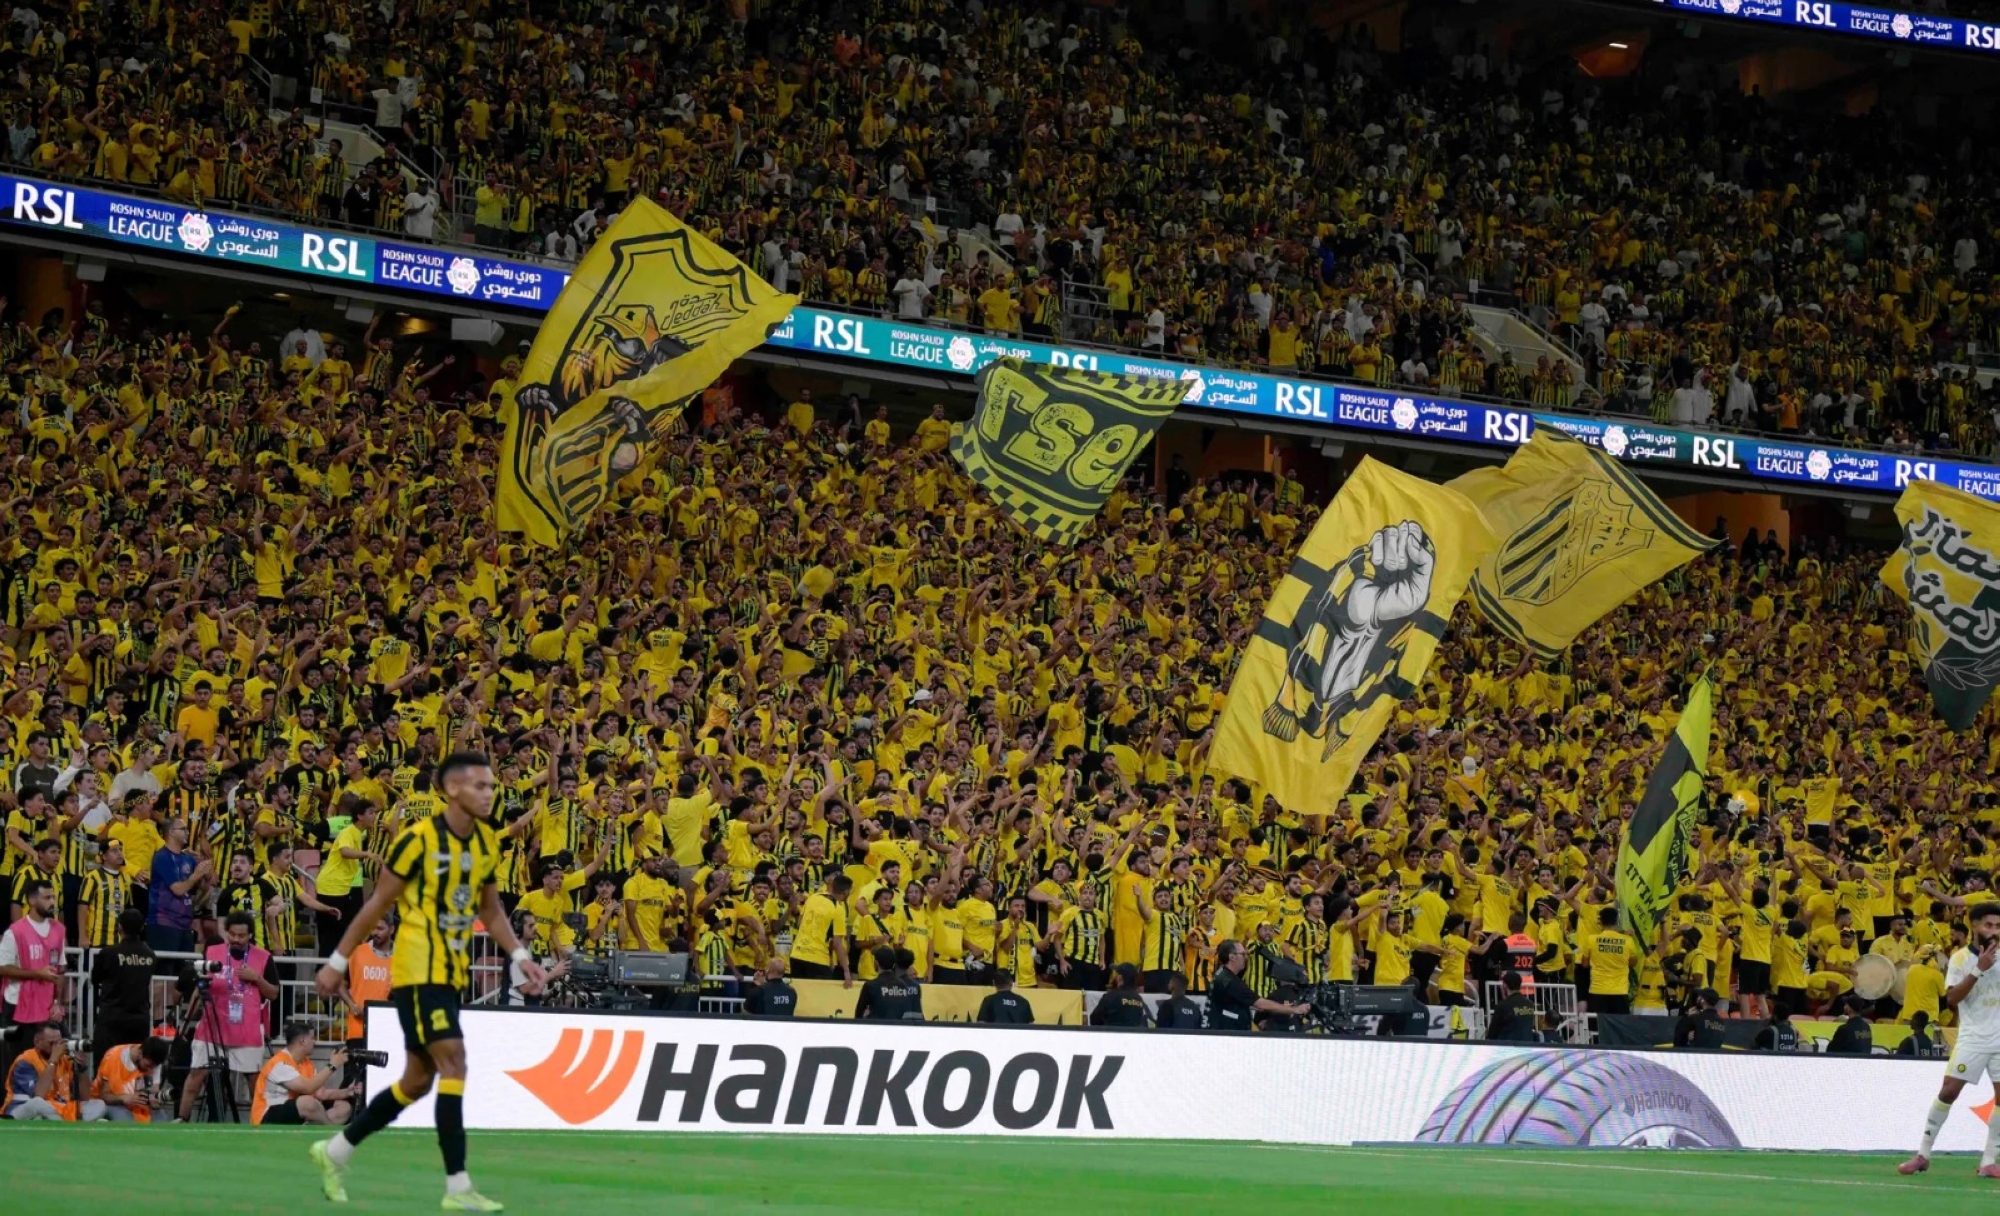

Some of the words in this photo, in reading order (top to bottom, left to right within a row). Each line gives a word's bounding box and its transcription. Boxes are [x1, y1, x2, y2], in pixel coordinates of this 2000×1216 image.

[1795, 1, 1837, 27] RSL
[1850, 18, 1890, 34] LEAGUE
[13, 183, 84, 229] RSL
[110, 203, 144, 218] ROSHN
[145, 208, 175, 223] SAUDI
[108, 216, 174, 242] LEAGUE
[217, 219, 249, 236] روشن
[251, 227, 279, 241] دوري
[216, 240, 279, 259] السعودي
[301, 233, 366, 277] RSL
[383, 249, 416, 264] ROSHN
[416, 253, 444, 268] SAUDI
[382, 262, 443, 287] LEAGUE
[483, 263, 514, 281] روشن
[515, 271, 542, 283] دوري
[483, 283, 541, 300] السعودي
[813, 314, 870, 354] RSL
[891, 330, 919, 342] ROSHN
[920, 333, 945, 346] SAUDI
[890, 343, 944, 364] LEAGUE
[1124, 363, 1150, 376] ROSHN
[1152, 367, 1175, 379] SAUDI
[1208, 374, 1234, 388] روشن
[1235, 380, 1258, 391] دوري
[1207, 391, 1258, 406] السعودي
[1275, 383, 1328, 418] RSL
[1339, 393, 1366, 405] ROSHN
[1367, 396, 1389, 408] SAUDI
[1339, 404, 1389, 425] LEAGUE
[1420, 402, 1445, 416] روشن
[1446, 408, 1468, 419] دوري
[1419, 419, 1468, 434] السعودي
[1484, 410, 1533, 443] RSL
[1578, 424, 1600, 435] SAUDI
[1630, 429, 1654, 443] روشن
[1655, 435, 1677, 445] دوري
[1629, 446, 1676, 460] السعودي
[1692, 436, 1741, 469] RSL
[1757, 446, 1782, 457] ROSHN
[1783, 448, 1804, 460] SAUDI
[1833, 453, 1858, 465] روشن
[1757, 457, 1804, 476] LEAGUE
[1858, 458, 1879, 468] دوري
[1833, 468, 1879, 483] السعودي
[1958, 469, 1982, 479] ROSHN
[118, 953, 153, 966] Police
[1514, 956, 1533, 968] 202
[881, 985, 907, 997] Police
